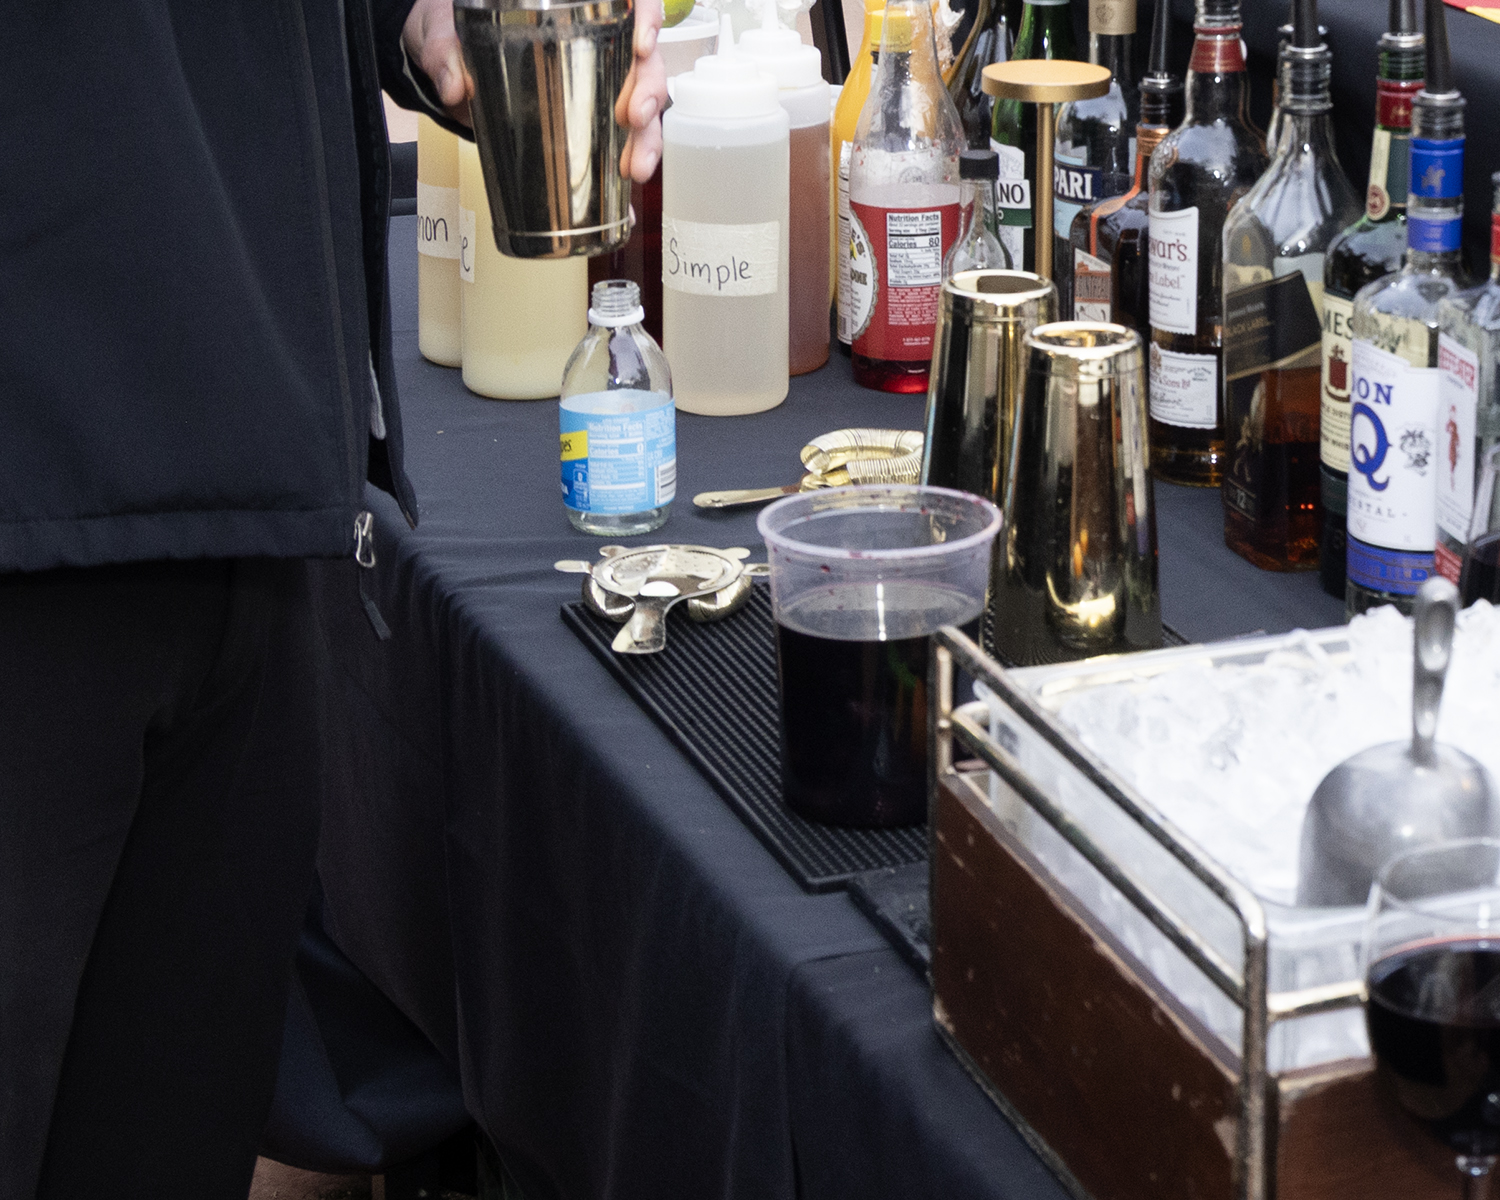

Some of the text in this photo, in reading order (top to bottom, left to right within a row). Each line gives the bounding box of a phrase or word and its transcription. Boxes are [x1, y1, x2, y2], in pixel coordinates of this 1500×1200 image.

[998, 182, 1025, 204] NO
[668, 237, 753, 290] Simple
[1352, 375, 1394, 405] ON
[1351, 402, 1392, 491] Q
